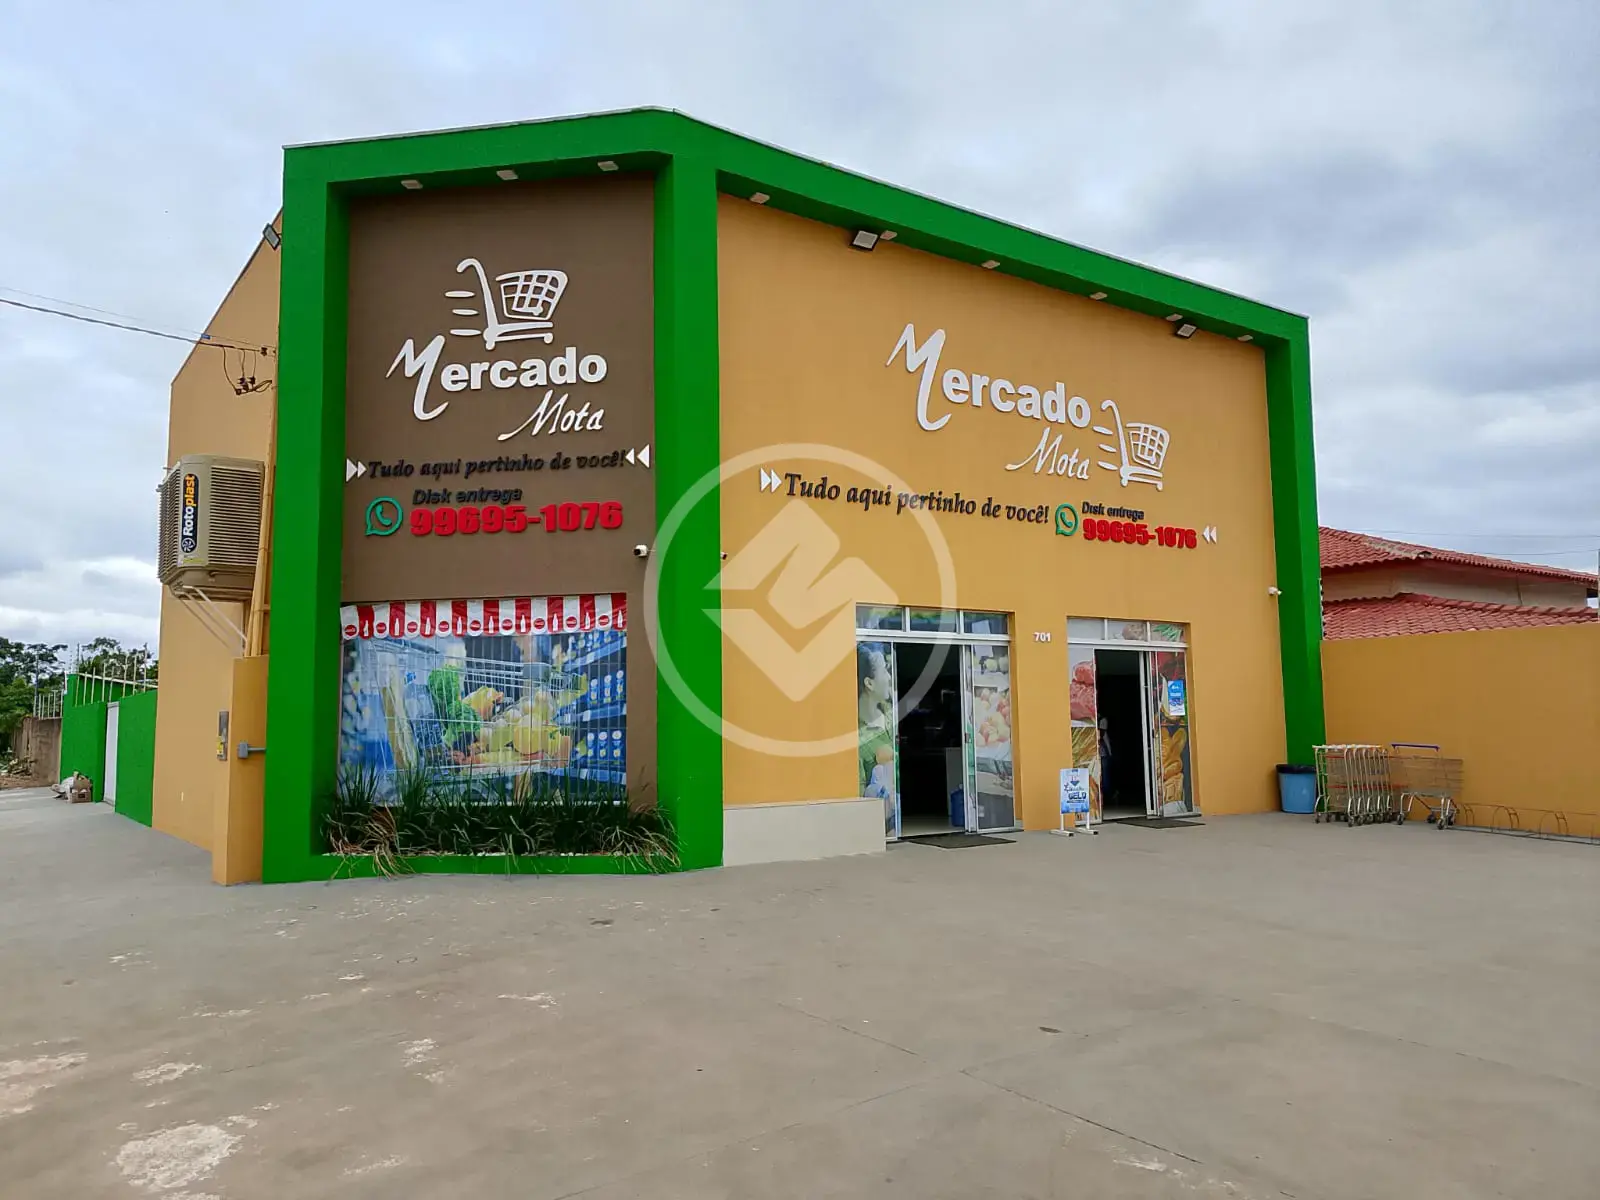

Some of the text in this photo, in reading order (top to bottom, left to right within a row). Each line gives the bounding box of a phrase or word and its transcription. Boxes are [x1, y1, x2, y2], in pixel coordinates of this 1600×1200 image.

[386, 335, 608, 421] Mercado
[885, 323, 1091, 431] Mercado
[497, 389, 604, 441] Mota
[368, 450, 626, 482] Tudo aqui pertinho de você!
[1005, 426, 1090, 481] Mota
[182, 474, 197, 536] Rotoplast
[412, 487, 522, 506] Disk entrega
[785, 472, 1049, 524] Tudo aqui pertinho de você!
[1081, 501, 1145, 522] Disk entrega
[409, 501, 623, 536] 99695-1076
[1082, 518, 1197, 549] 99695-1076
[1034, 632, 1051, 642] 701
